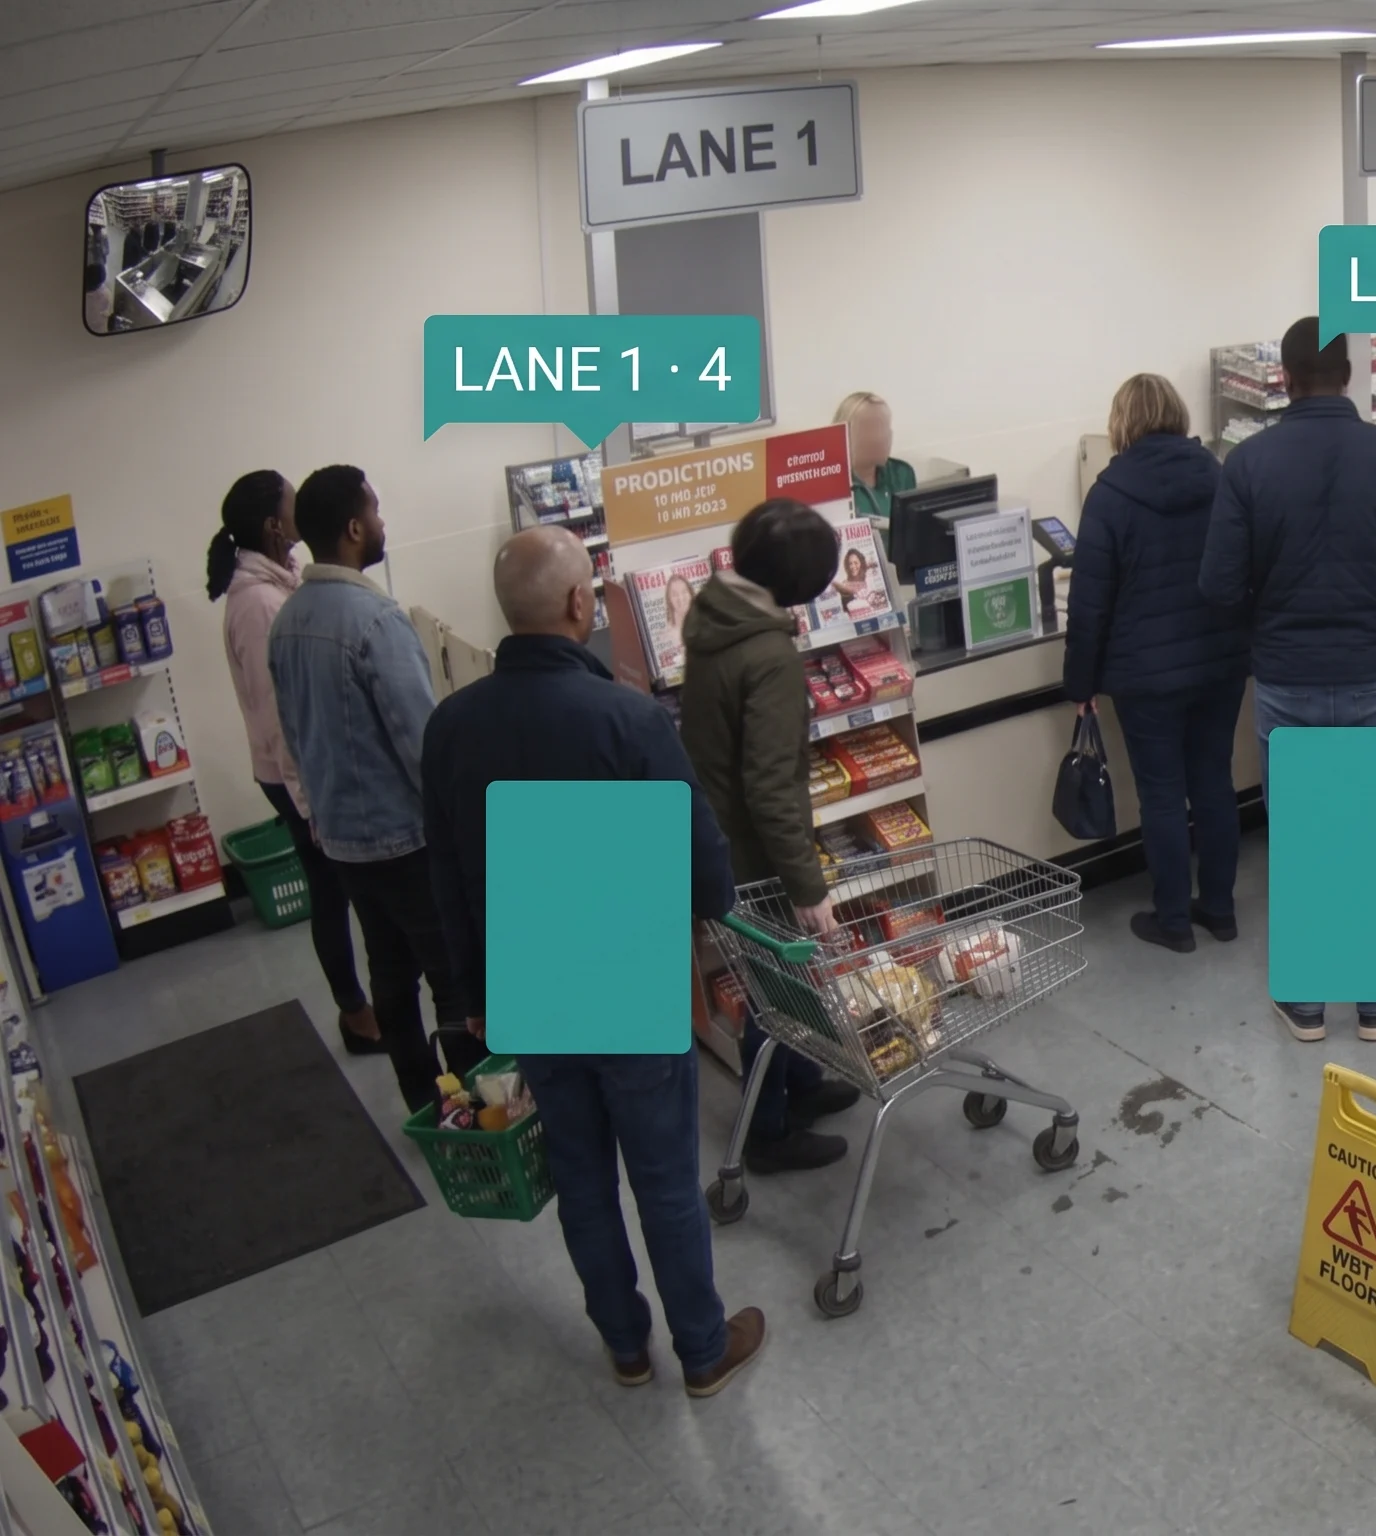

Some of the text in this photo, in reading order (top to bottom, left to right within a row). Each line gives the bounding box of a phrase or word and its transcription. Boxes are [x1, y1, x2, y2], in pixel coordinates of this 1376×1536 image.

[620, 119, 818, 186] LANE 1
[614, 452, 755, 496] PRODICTIONS
[694, 498, 728, 516] 2023
